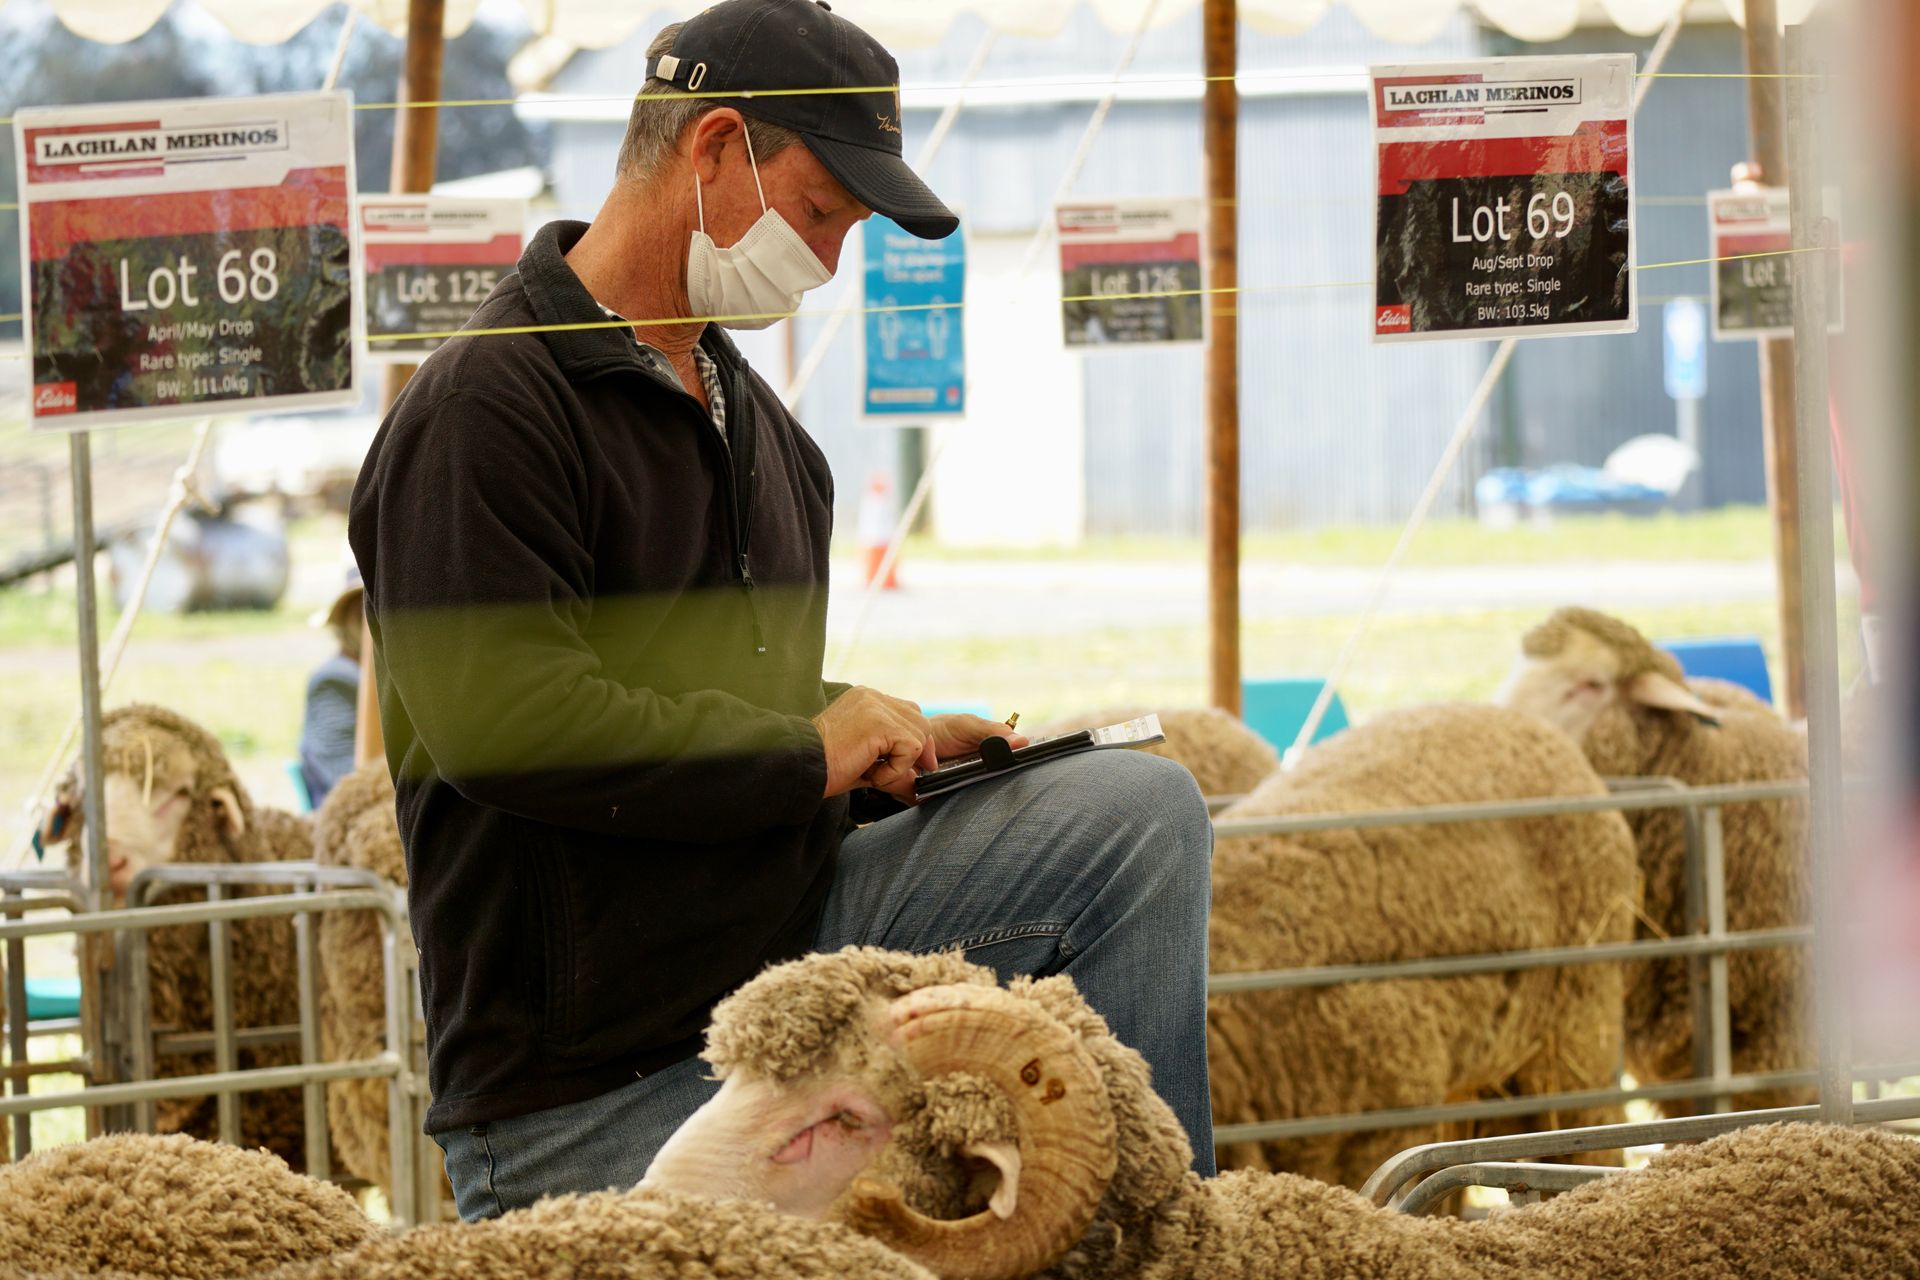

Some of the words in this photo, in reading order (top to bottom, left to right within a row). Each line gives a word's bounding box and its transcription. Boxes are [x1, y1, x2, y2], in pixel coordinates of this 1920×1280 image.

[1390, 88, 1479, 105] LACHLAN
[1486, 85, 1574, 102] MERINOS
[44, 137, 157, 158] LACHLAN
[166, 129, 278, 151] MERINOS
[1452, 196, 1511, 243] Lot
[1527, 192, 1575, 239] 69
[1472, 255, 1524, 272] Aug/Sept
[1527, 254, 1554, 269] Drop
[120, 255, 199, 311] Lot
[216, 247, 279, 304] 68
[397, 271, 440, 303] Lot
[1465, 282, 1491, 295] Rare
[1494, 281, 1523, 296] type:
[1527, 277, 1561, 295] Single
[1478, 306, 1500, 320] BW:
[1505, 303, 1549, 319] 103.5kg
[147, 321, 216, 345] April/May
[219, 318, 255, 338] Drop
[140, 353, 174, 370] Rare
[178, 351, 215, 371] type:
[219, 344, 263, 367] Single
[157, 380, 187, 398] BW:
[193, 375, 248, 395] 111.0kg
